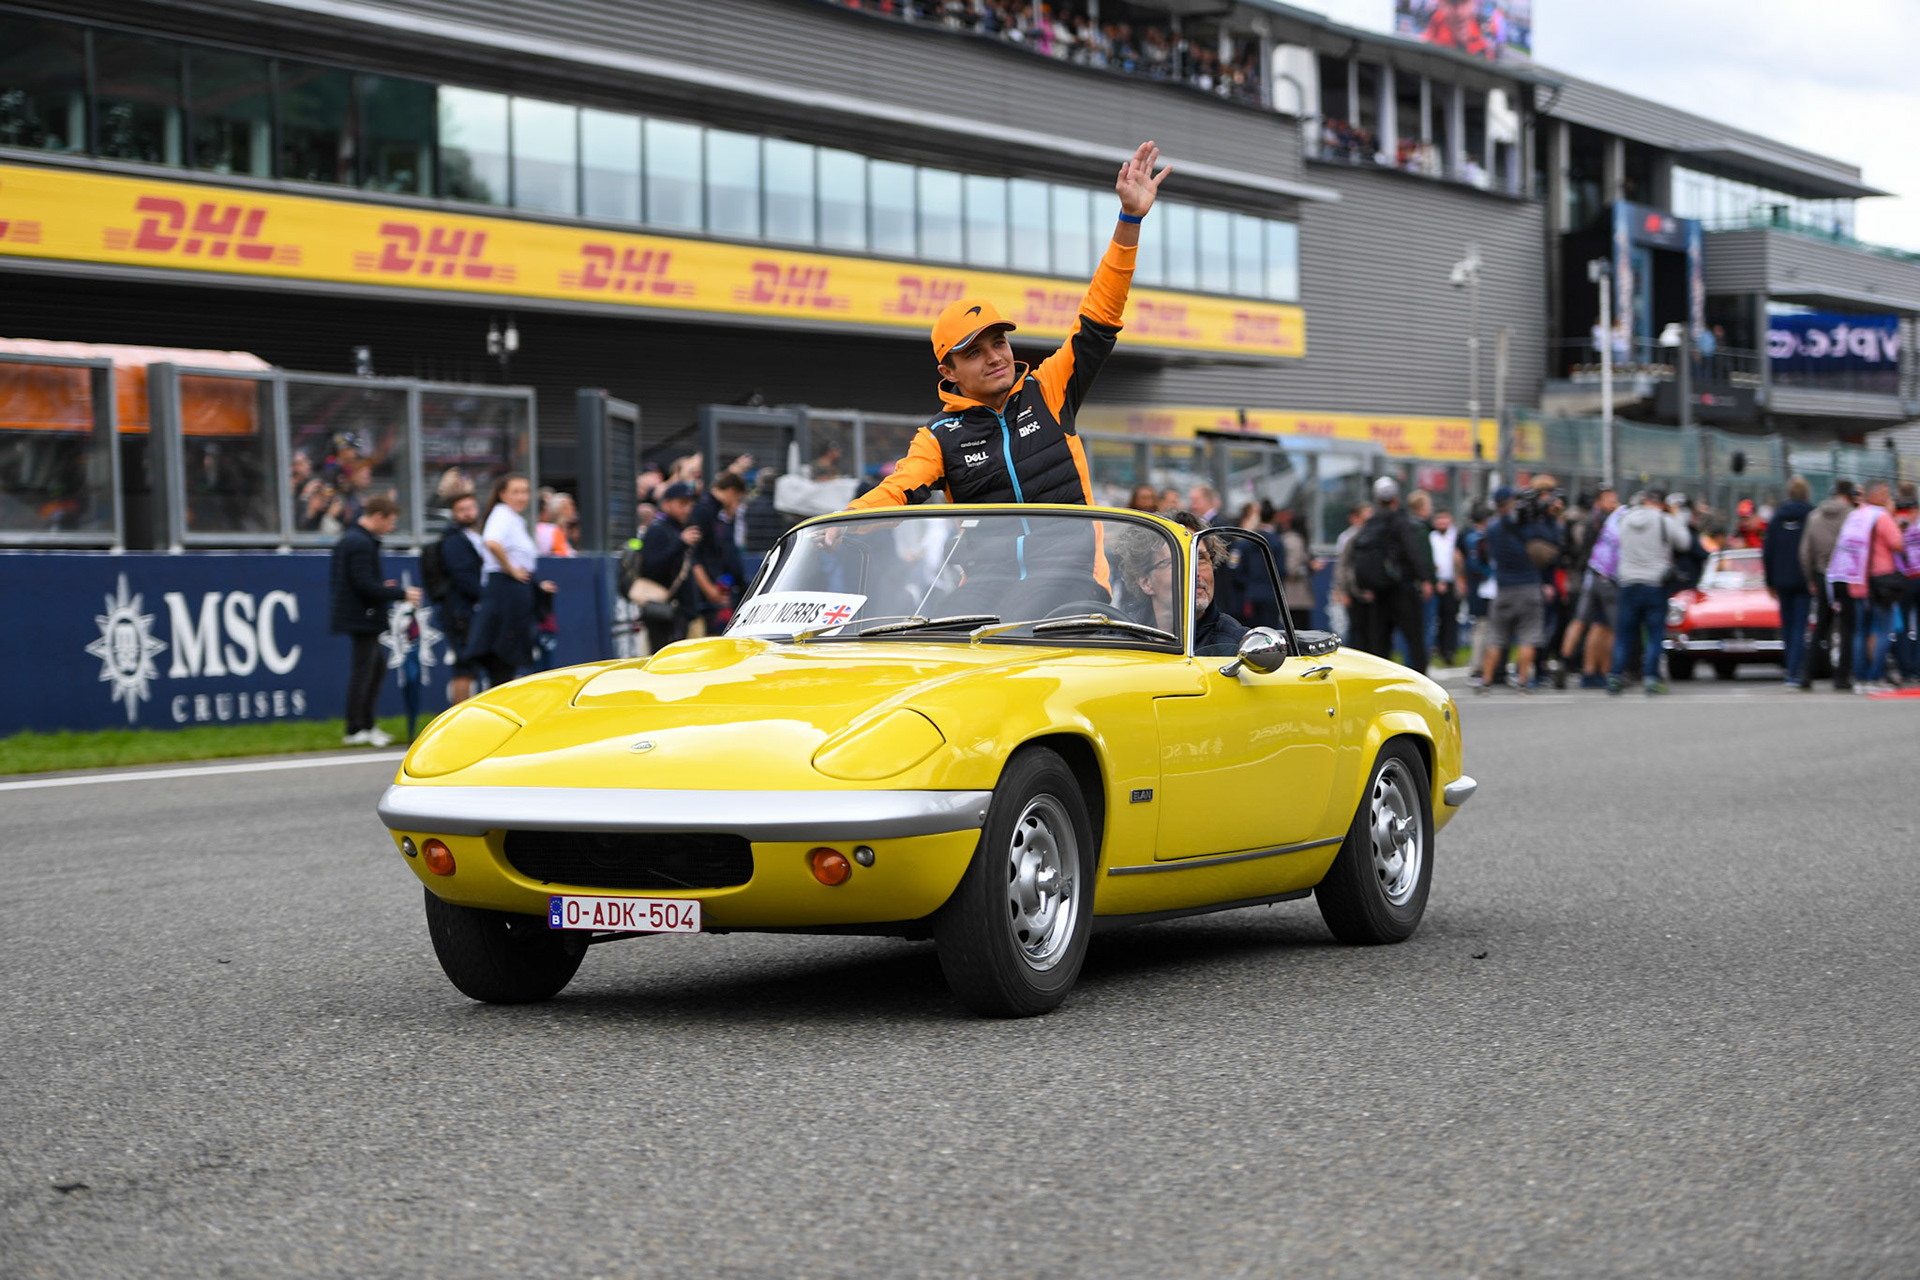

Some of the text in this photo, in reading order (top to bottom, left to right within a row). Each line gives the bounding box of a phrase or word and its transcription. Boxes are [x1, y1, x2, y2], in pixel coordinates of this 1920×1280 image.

[134, 195, 275, 261] DHL
[378, 222, 494, 279] DHL
[579, 243, 677, 295] DHL
[751, 261, 833, 308] DHL
[964, 451, 989, 464] DELL
[772, 602, 827, 624] NORRIS
[163, 590, 302, 679] MSC
[171, 689, 307, 723] CRUISES
[1133, 790, 1151, 800] ELAN
[552, 915, 560, 925] B
